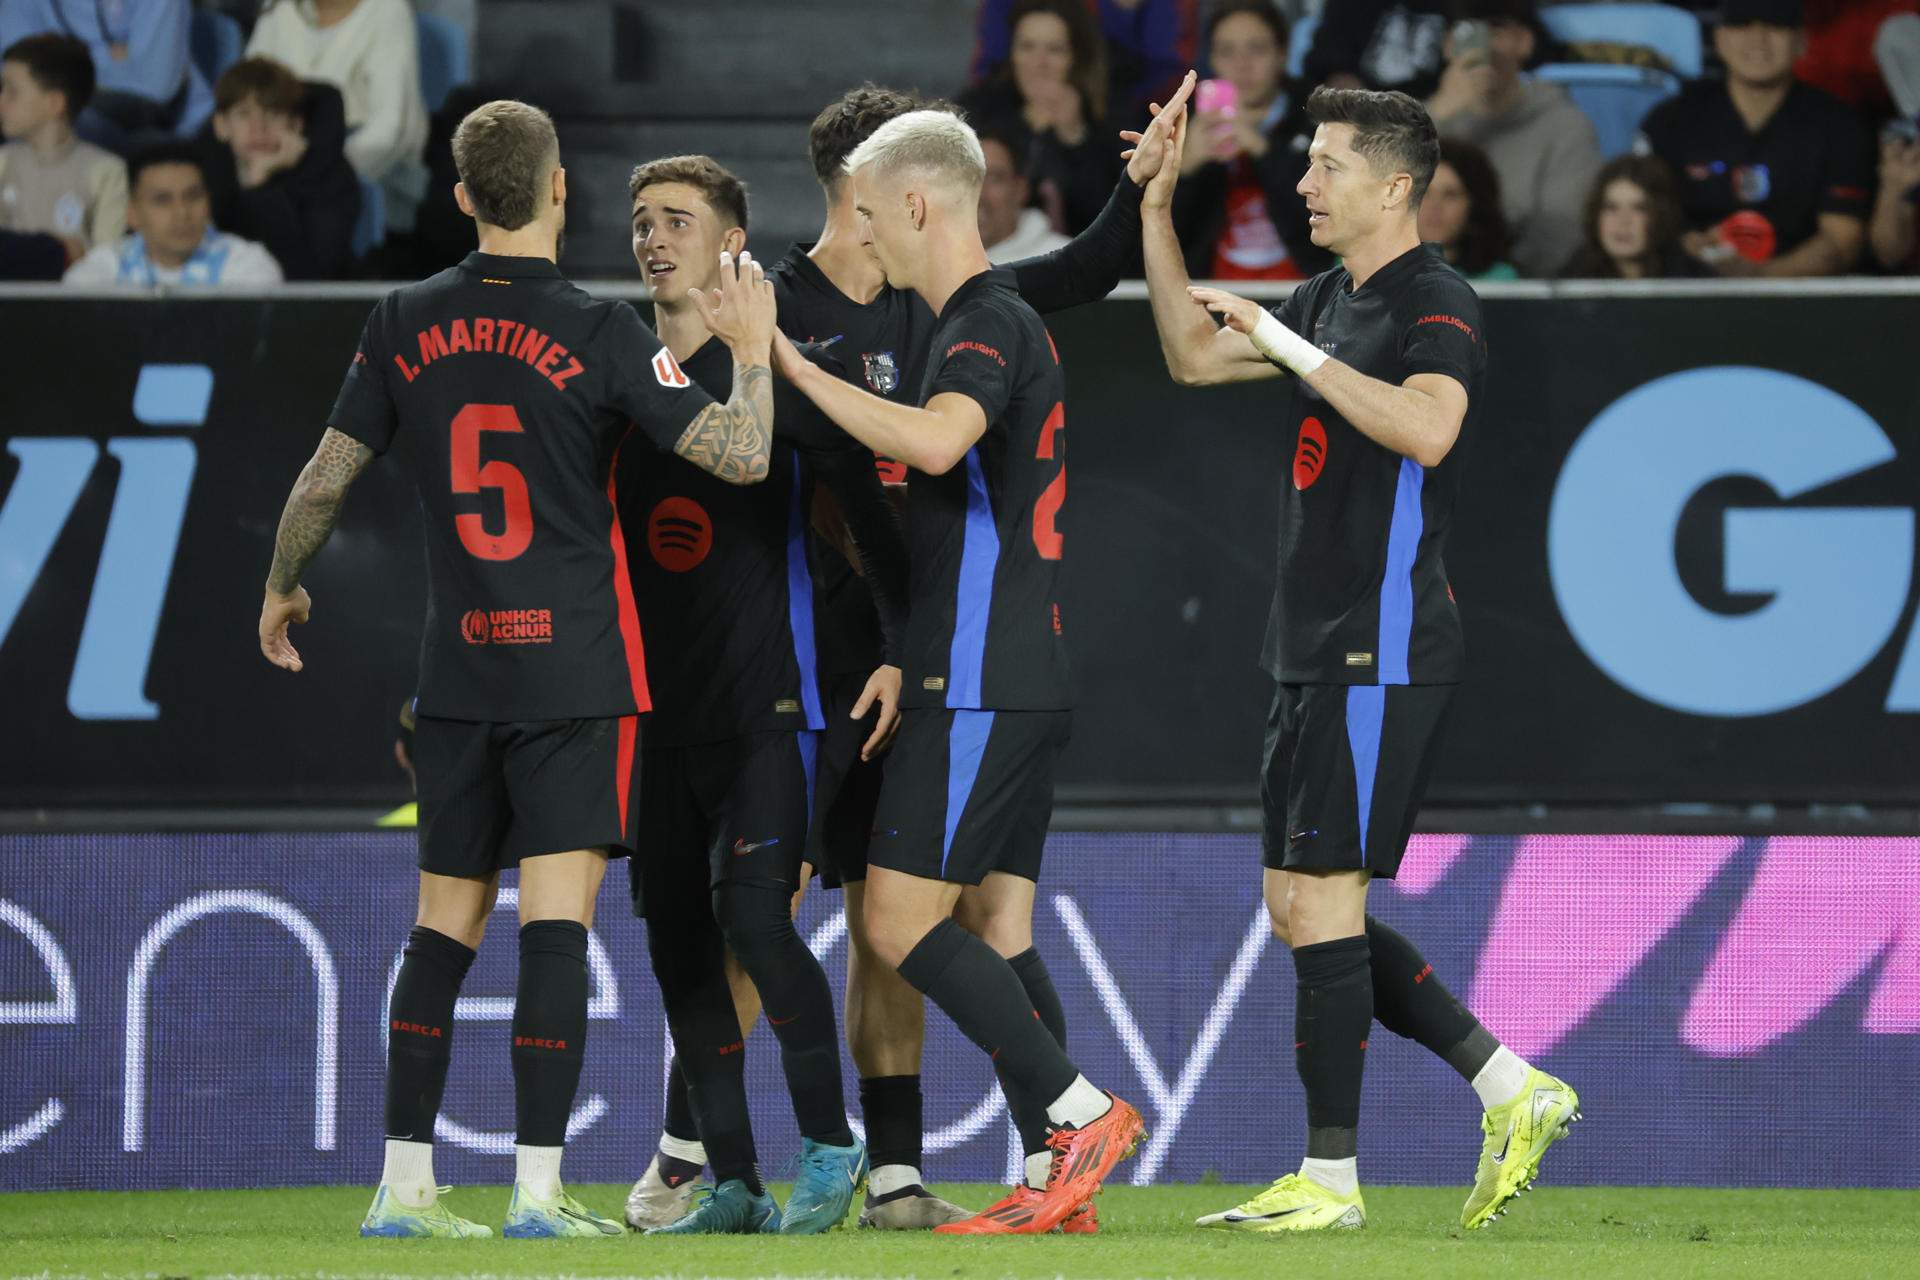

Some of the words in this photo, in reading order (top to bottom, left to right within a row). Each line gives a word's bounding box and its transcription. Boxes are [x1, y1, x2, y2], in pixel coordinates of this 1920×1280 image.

[393, 353, 421, 382] I.
[417, 317, 585, 391] MARTINEZ
[946, 341, 1000, 358] AMBILIGHT
[450, 402, 534, 561] 5
[1547, 364, 1920, 718] G
[489, 608, 553, 625] UNHCR
[491, 622, 553, 639] ACNUR
